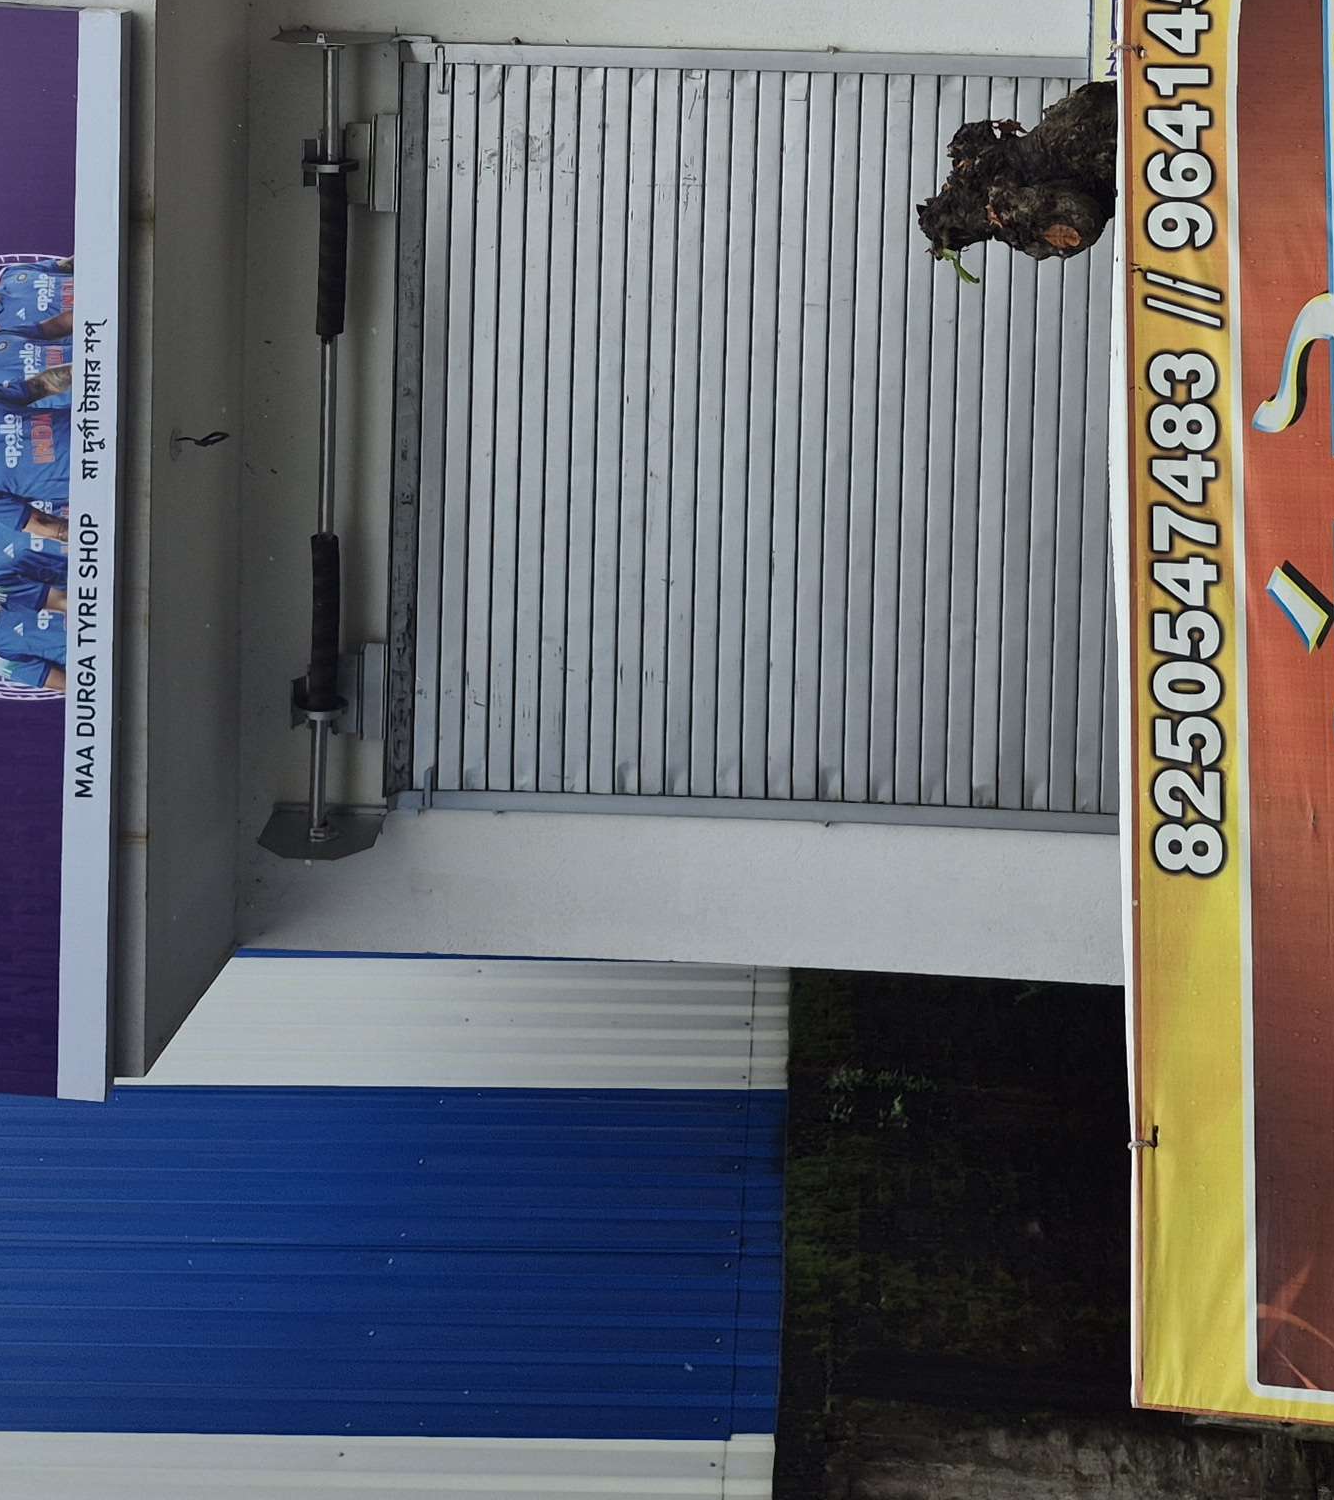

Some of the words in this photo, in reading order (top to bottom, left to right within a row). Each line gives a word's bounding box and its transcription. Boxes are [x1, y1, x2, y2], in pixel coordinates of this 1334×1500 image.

[33, 273, 53, 312] apollo
[83, 318, 108, 353] শপ্
[76, 358, 101, 413] টায়ার
[0, 413, 22, 469] apollo
[76, 417, 106, 454] দুর্গা
[80, 458, 100, 480] মা
[78, 512, 99, 580] SHOP
[77, 586, 98, 648] TYRE
[1148, 350, 1225, 877] 8250547483
[75, 654, 97, 738] DURGA
[73, 745, 95, 799] MAA
